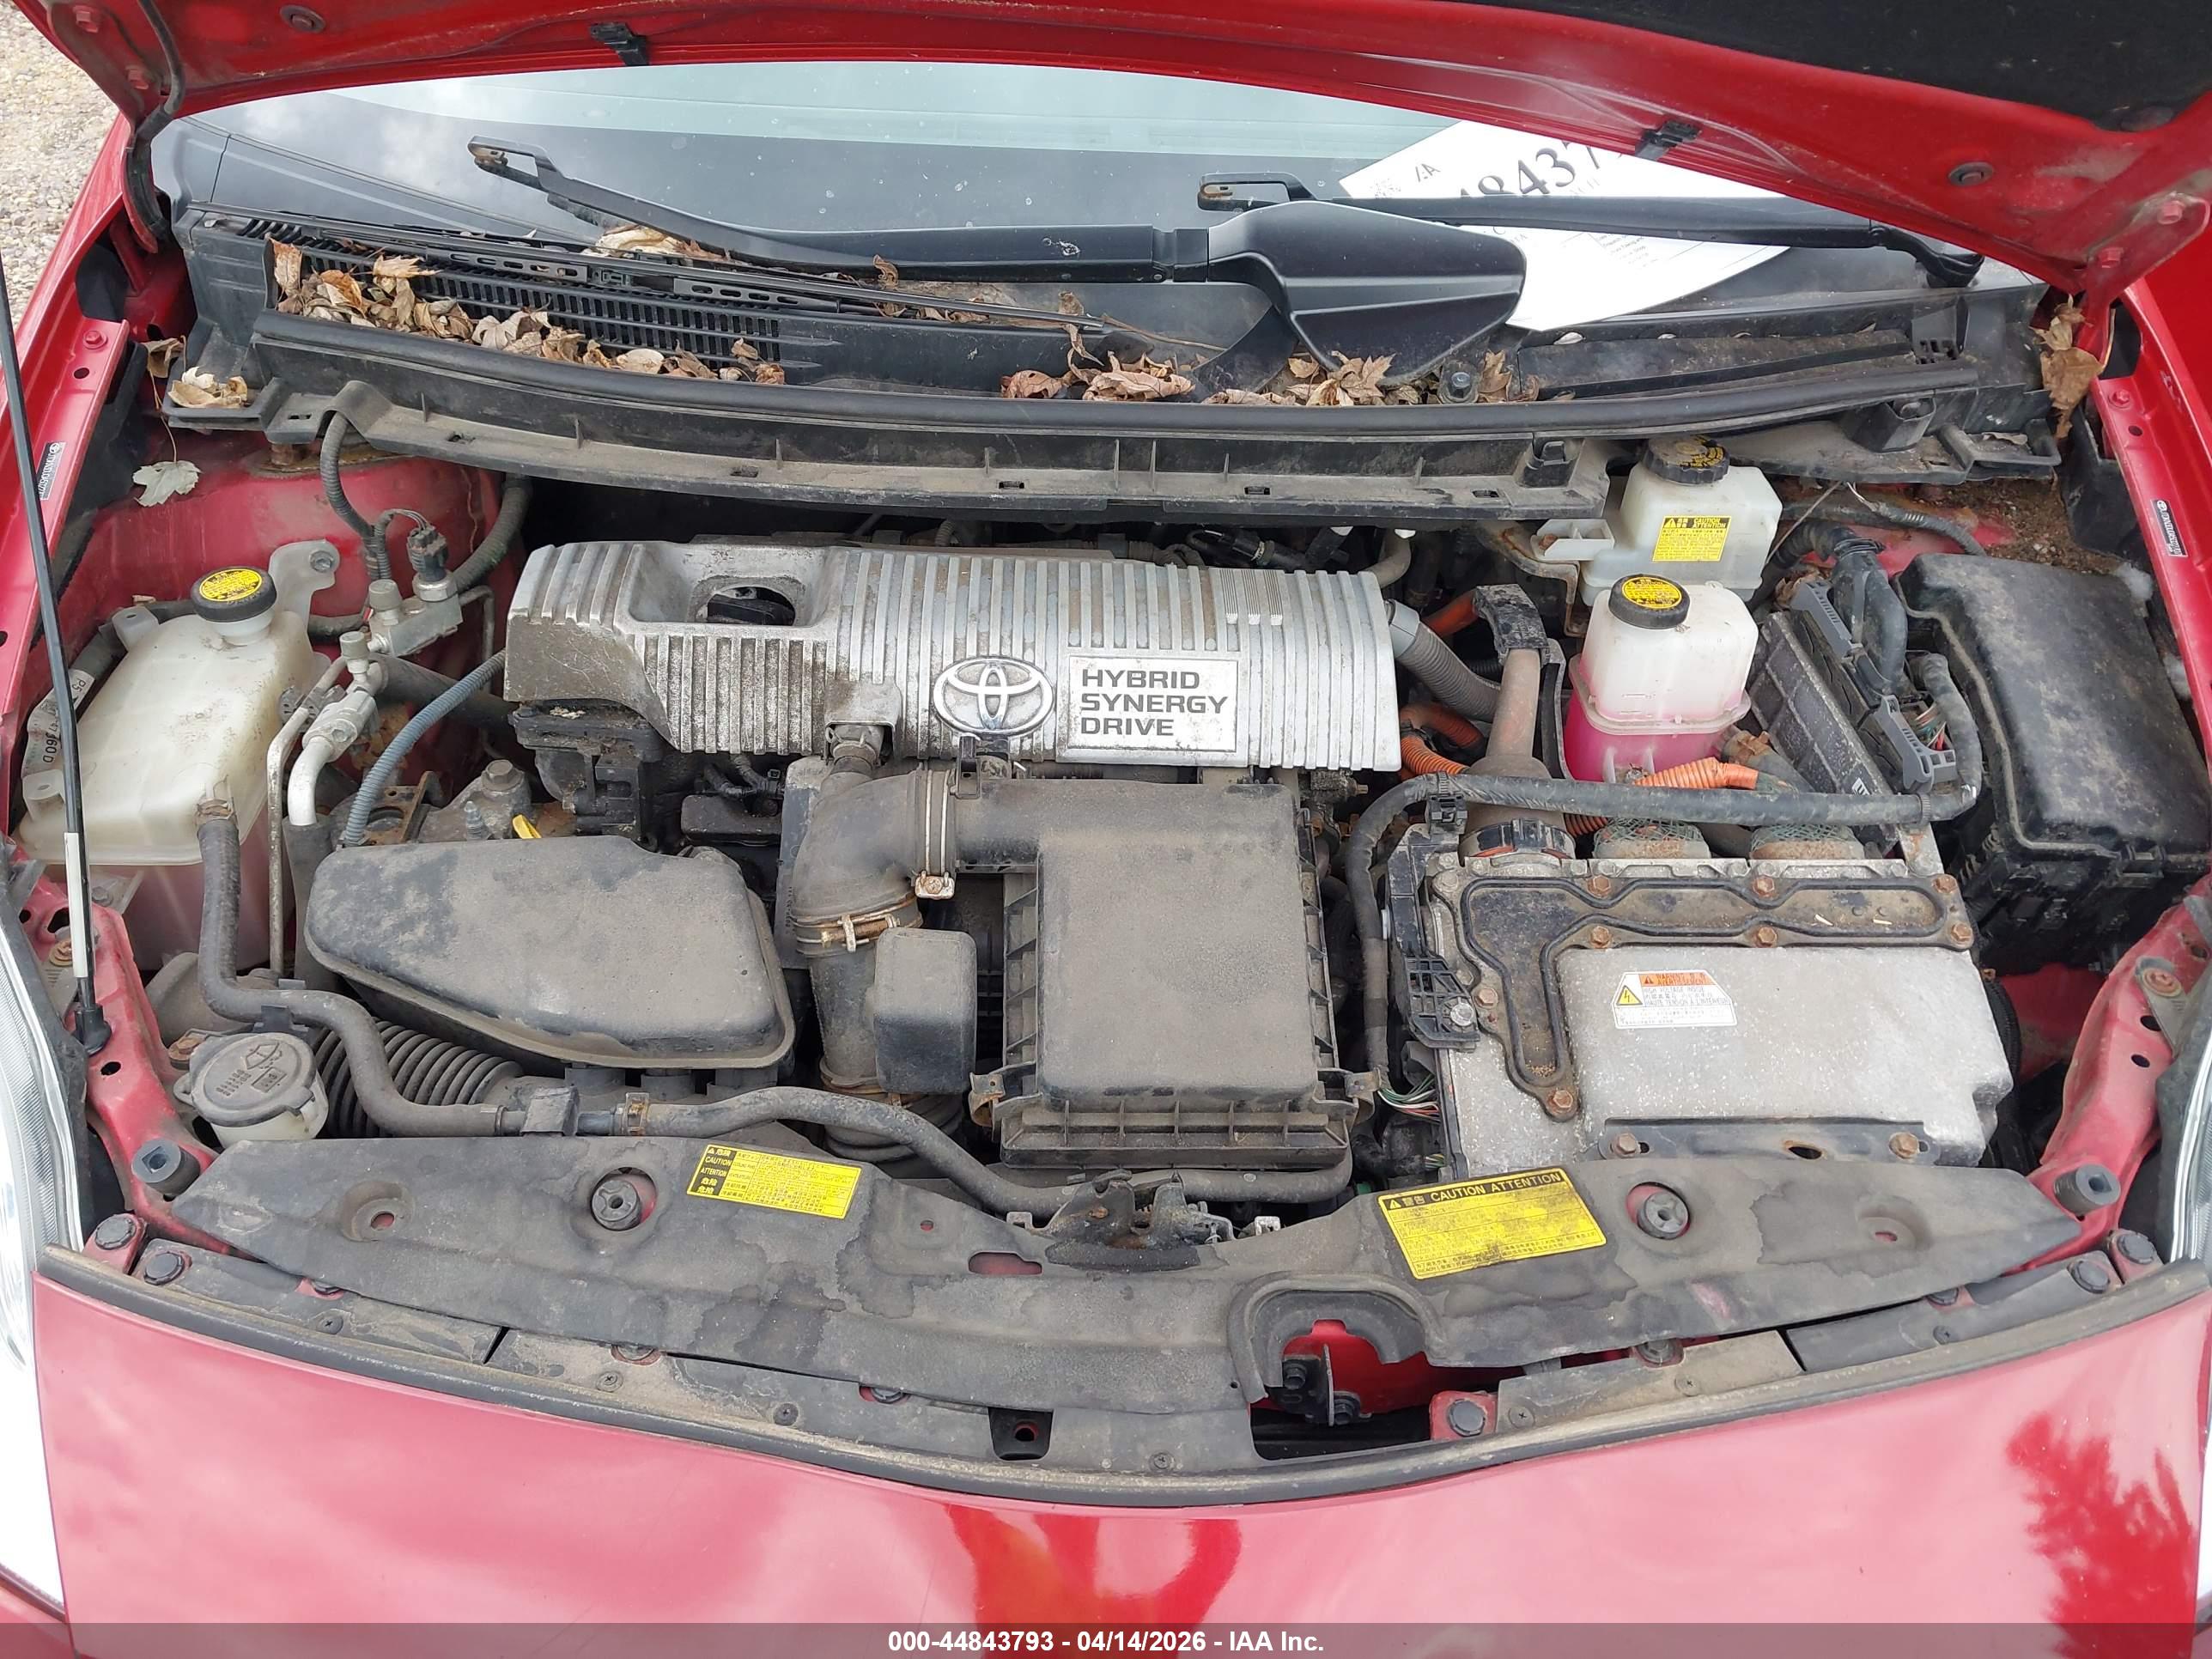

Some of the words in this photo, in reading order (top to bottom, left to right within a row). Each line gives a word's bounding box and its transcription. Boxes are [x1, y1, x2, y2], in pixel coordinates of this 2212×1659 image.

[1082, 669, 1200, 689] HYBRID
[1080, 693, 1228, 714] SYNERGY
[1080, 717, 1174, 736] DRIVE
[705, 1156, 732, 1167] CAUTION
[701, 1167, 728, 1177] ATTENTION
[1430, 1185, 1486, 1202] CAUTION
[1491, 1172, 1562, 1193] ATTENTION
